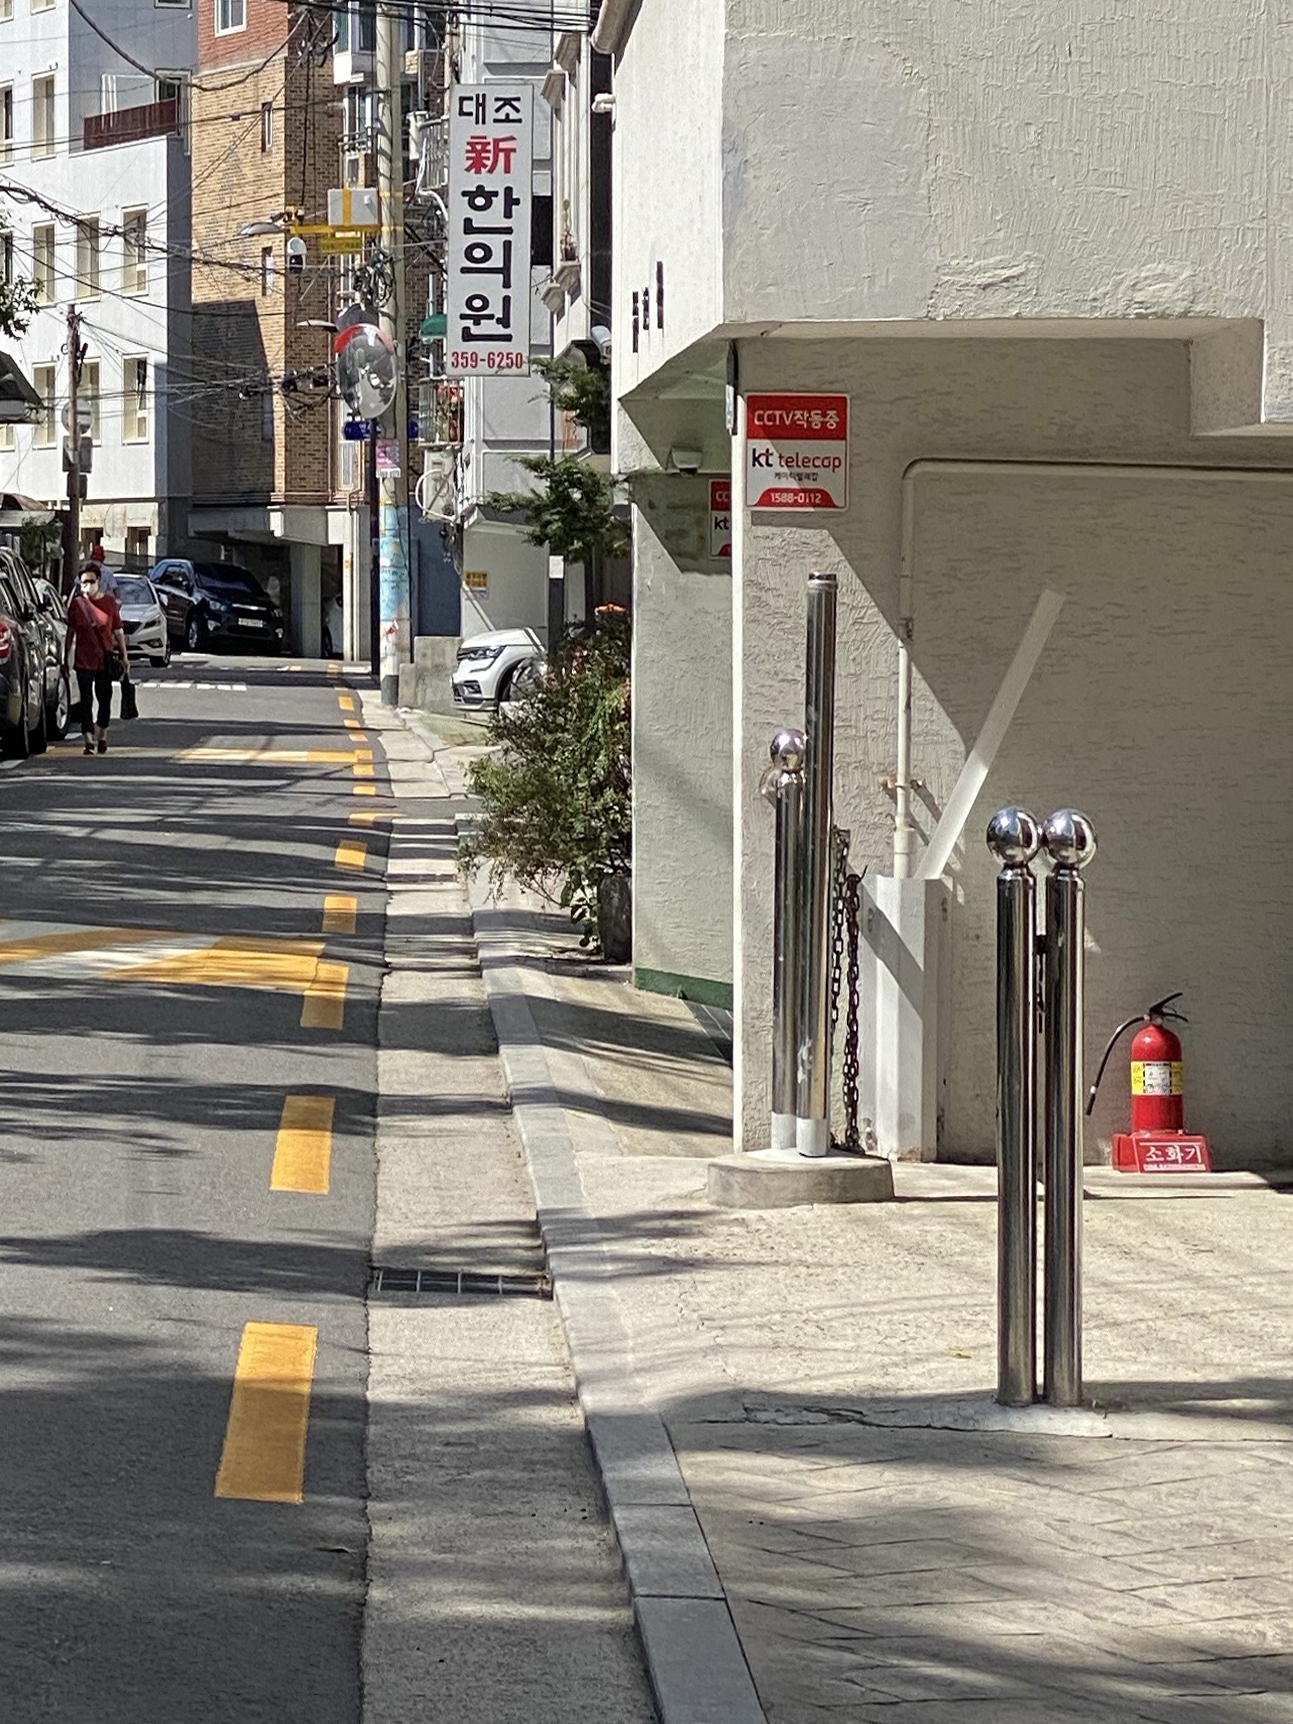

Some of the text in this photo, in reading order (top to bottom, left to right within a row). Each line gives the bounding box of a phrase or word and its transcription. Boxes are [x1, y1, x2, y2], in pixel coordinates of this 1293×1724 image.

[458, 93, 523, 125] 대조
[464, 135, 517, 175] 新
[459, 184, 521, 343] 한의원
[451, 351, 524, 370] 359-6250
[754, 409, 840, 430] CCTV작동중
[752, 448, 774, 468] kt
[770, 492, 822, 503] 1588-0112
[1146, 1145, 1202, 1164] 소화기
